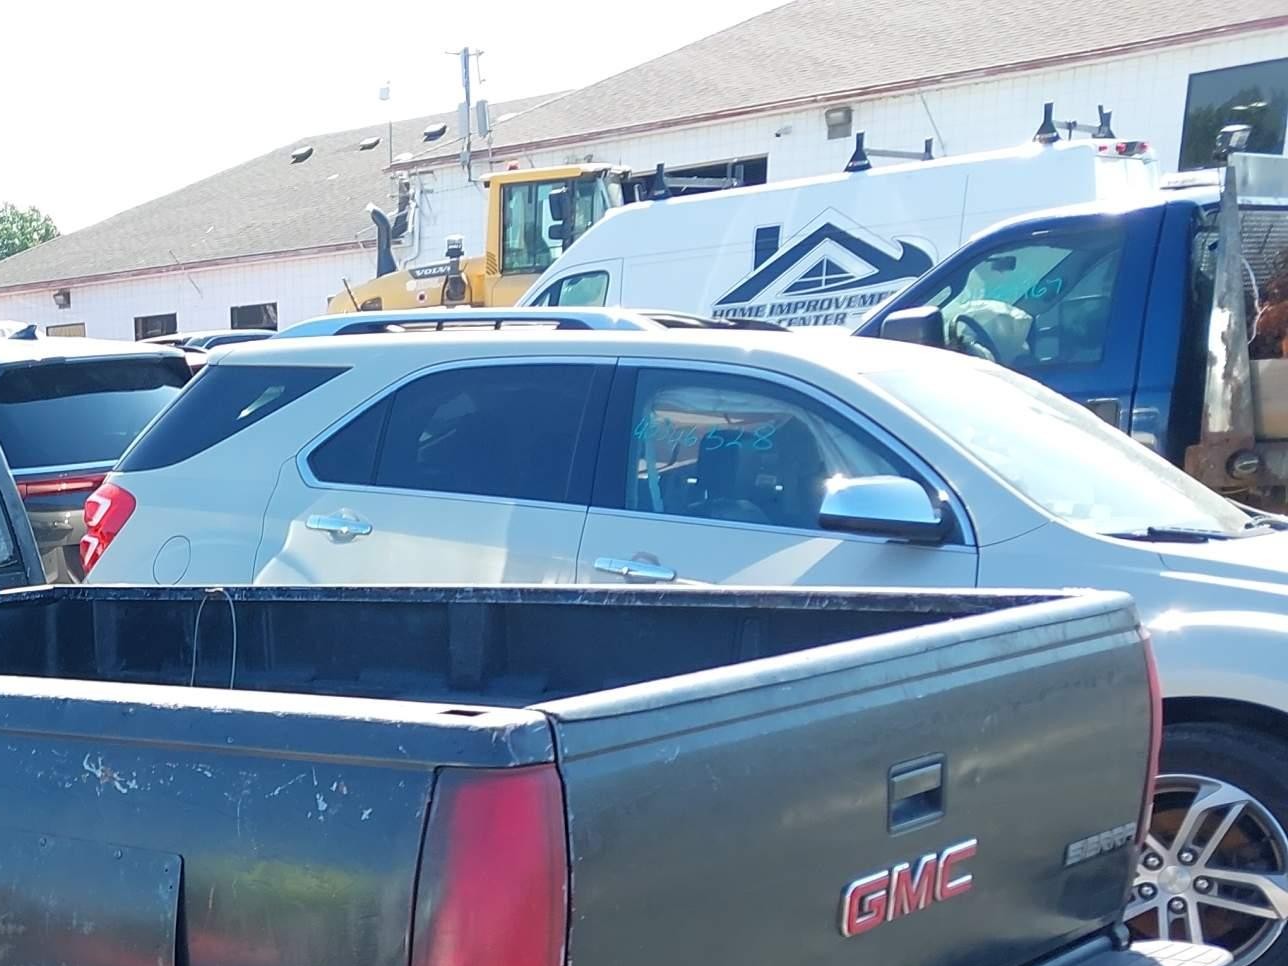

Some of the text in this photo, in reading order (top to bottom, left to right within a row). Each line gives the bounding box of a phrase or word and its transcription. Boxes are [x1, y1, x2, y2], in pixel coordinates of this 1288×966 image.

[415, 266, 451, 277] VOLV
[712, 290, 899, 320] HOME IMPROVEME
[841, 838, 978, 938] GMC
